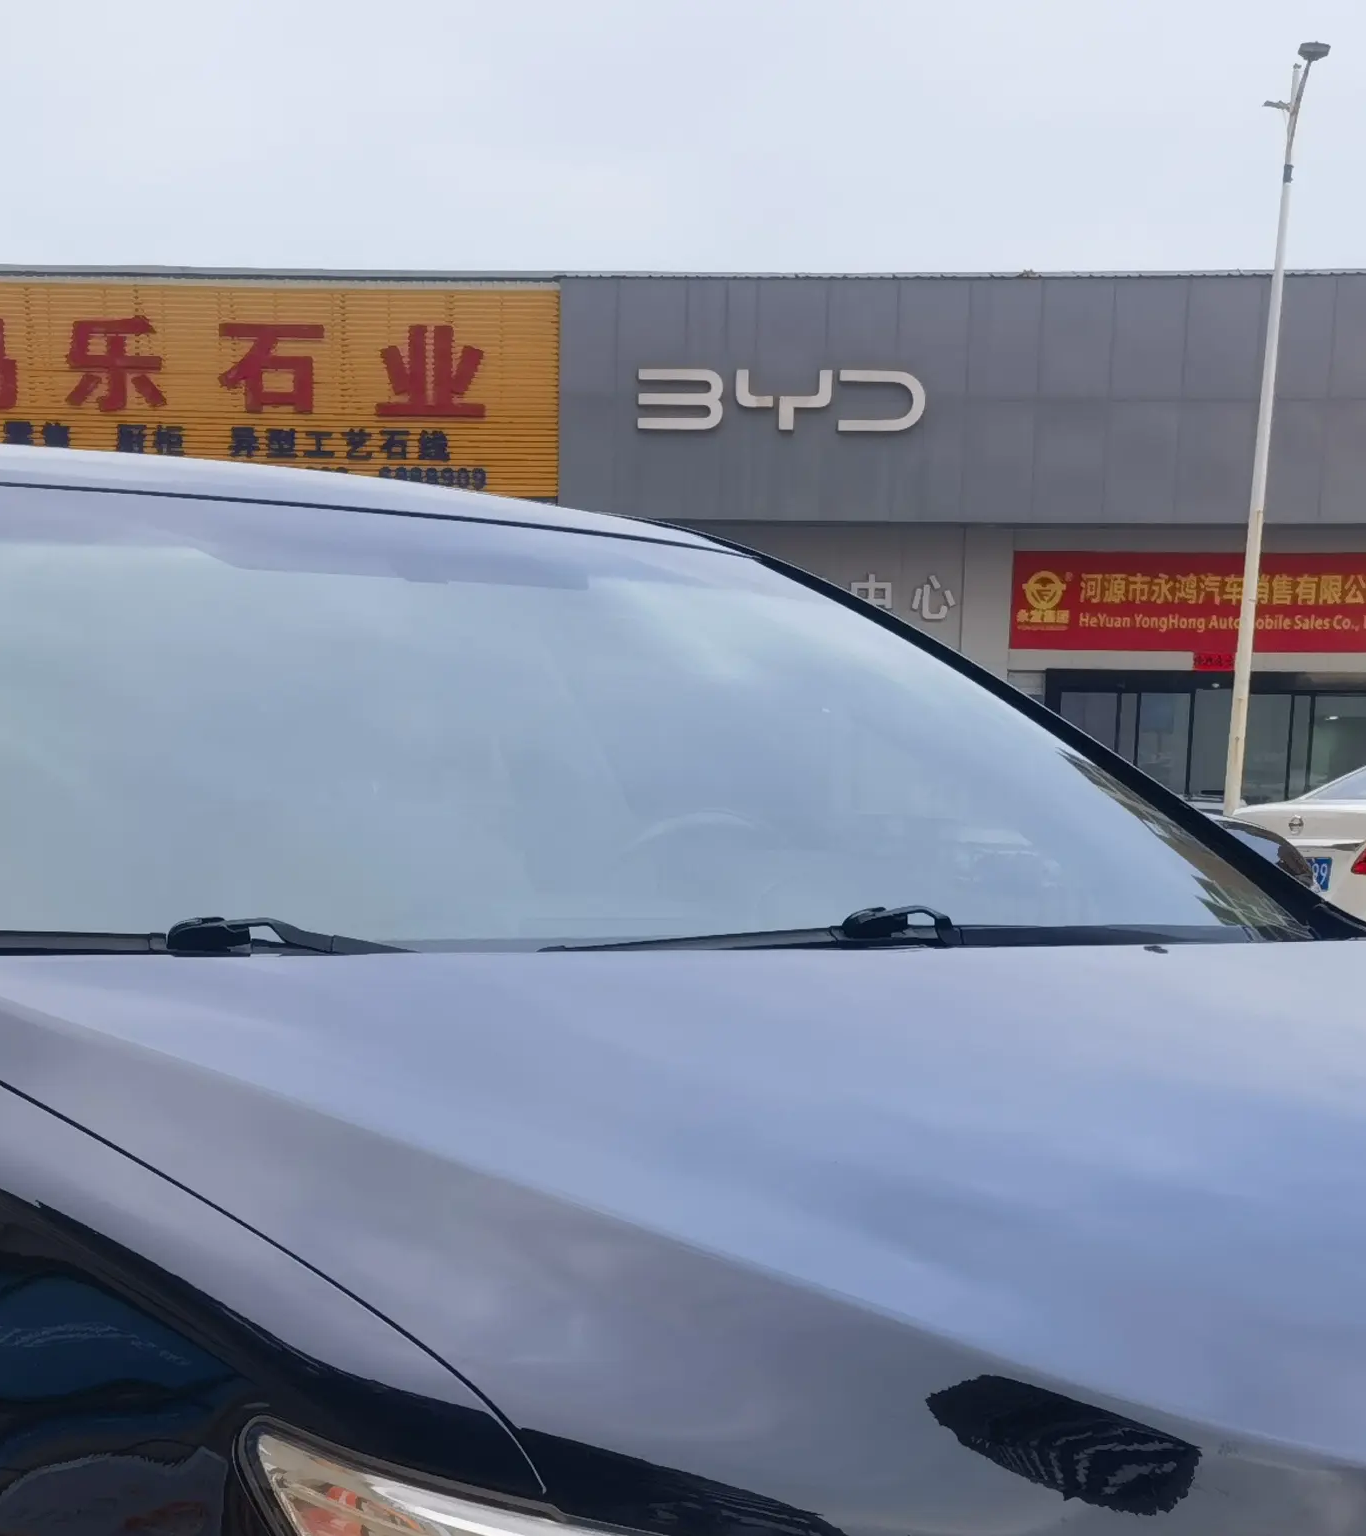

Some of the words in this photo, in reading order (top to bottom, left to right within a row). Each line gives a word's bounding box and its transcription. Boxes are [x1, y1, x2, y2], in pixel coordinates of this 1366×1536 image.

[637, 368, 927, 432] BYD
[1079, 612, 1131, 629] HeYuan
[1134, 612, 1206, 633] YongHong
[1208, 614, 1291, 631] Autoobile
[1294, 614, 1330, 631] Sales
